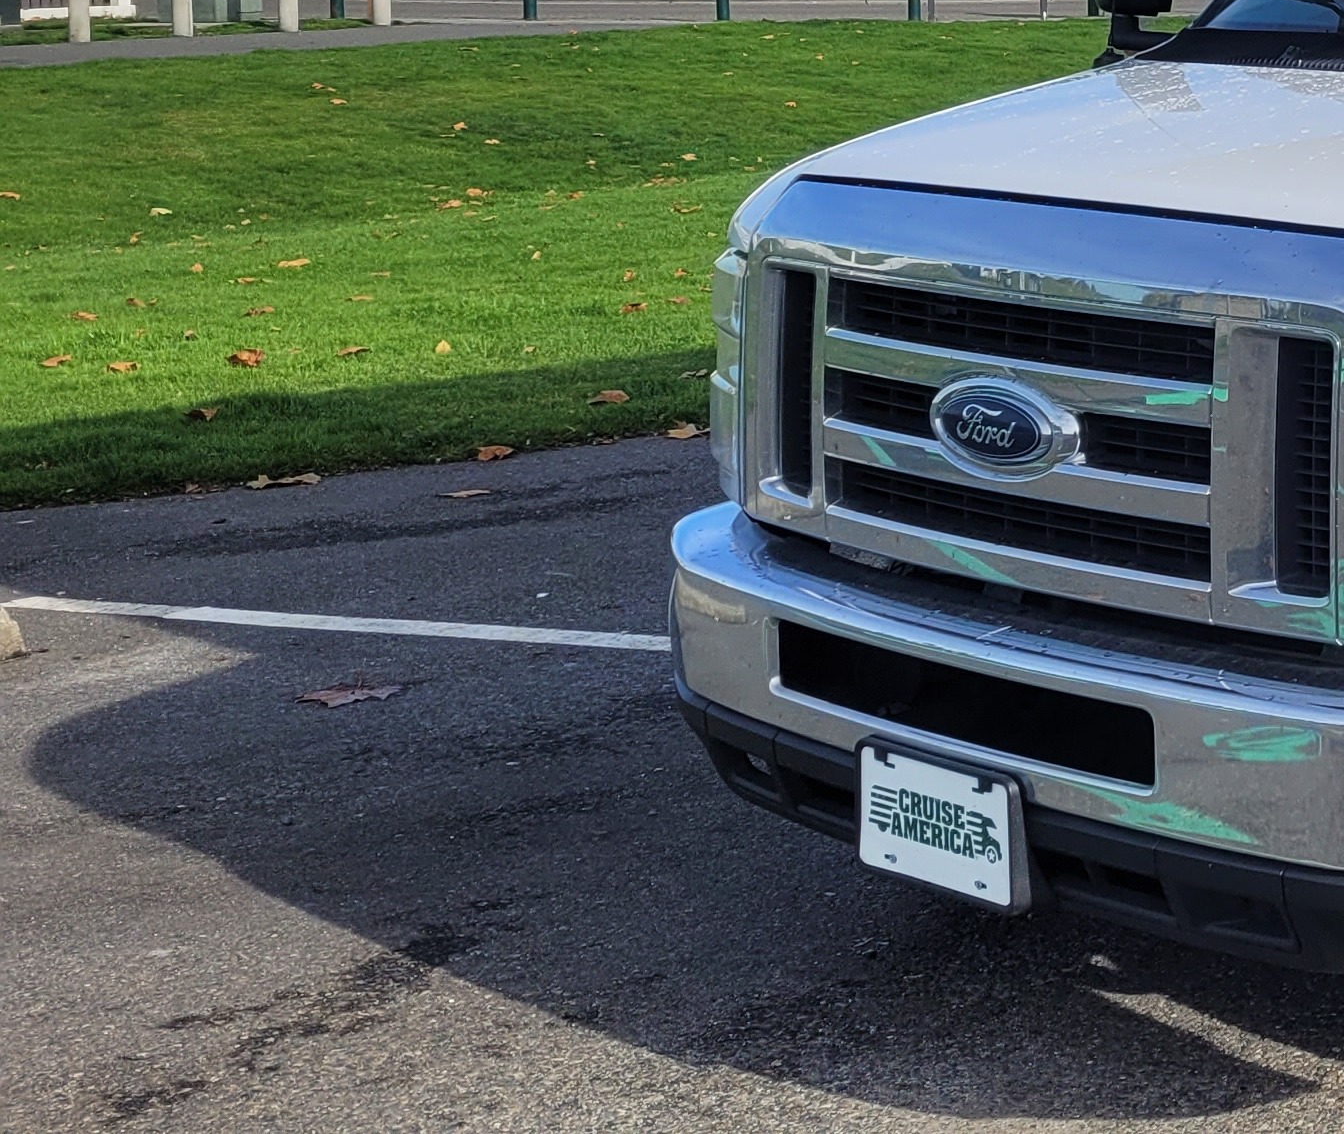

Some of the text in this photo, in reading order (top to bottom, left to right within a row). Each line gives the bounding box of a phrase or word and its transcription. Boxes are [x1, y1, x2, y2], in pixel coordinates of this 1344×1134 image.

[956, 403, 1017, 448] Ford
[899, 788, 965, 831] CRUISE
[891, 812, 975, 859] AMERICA
